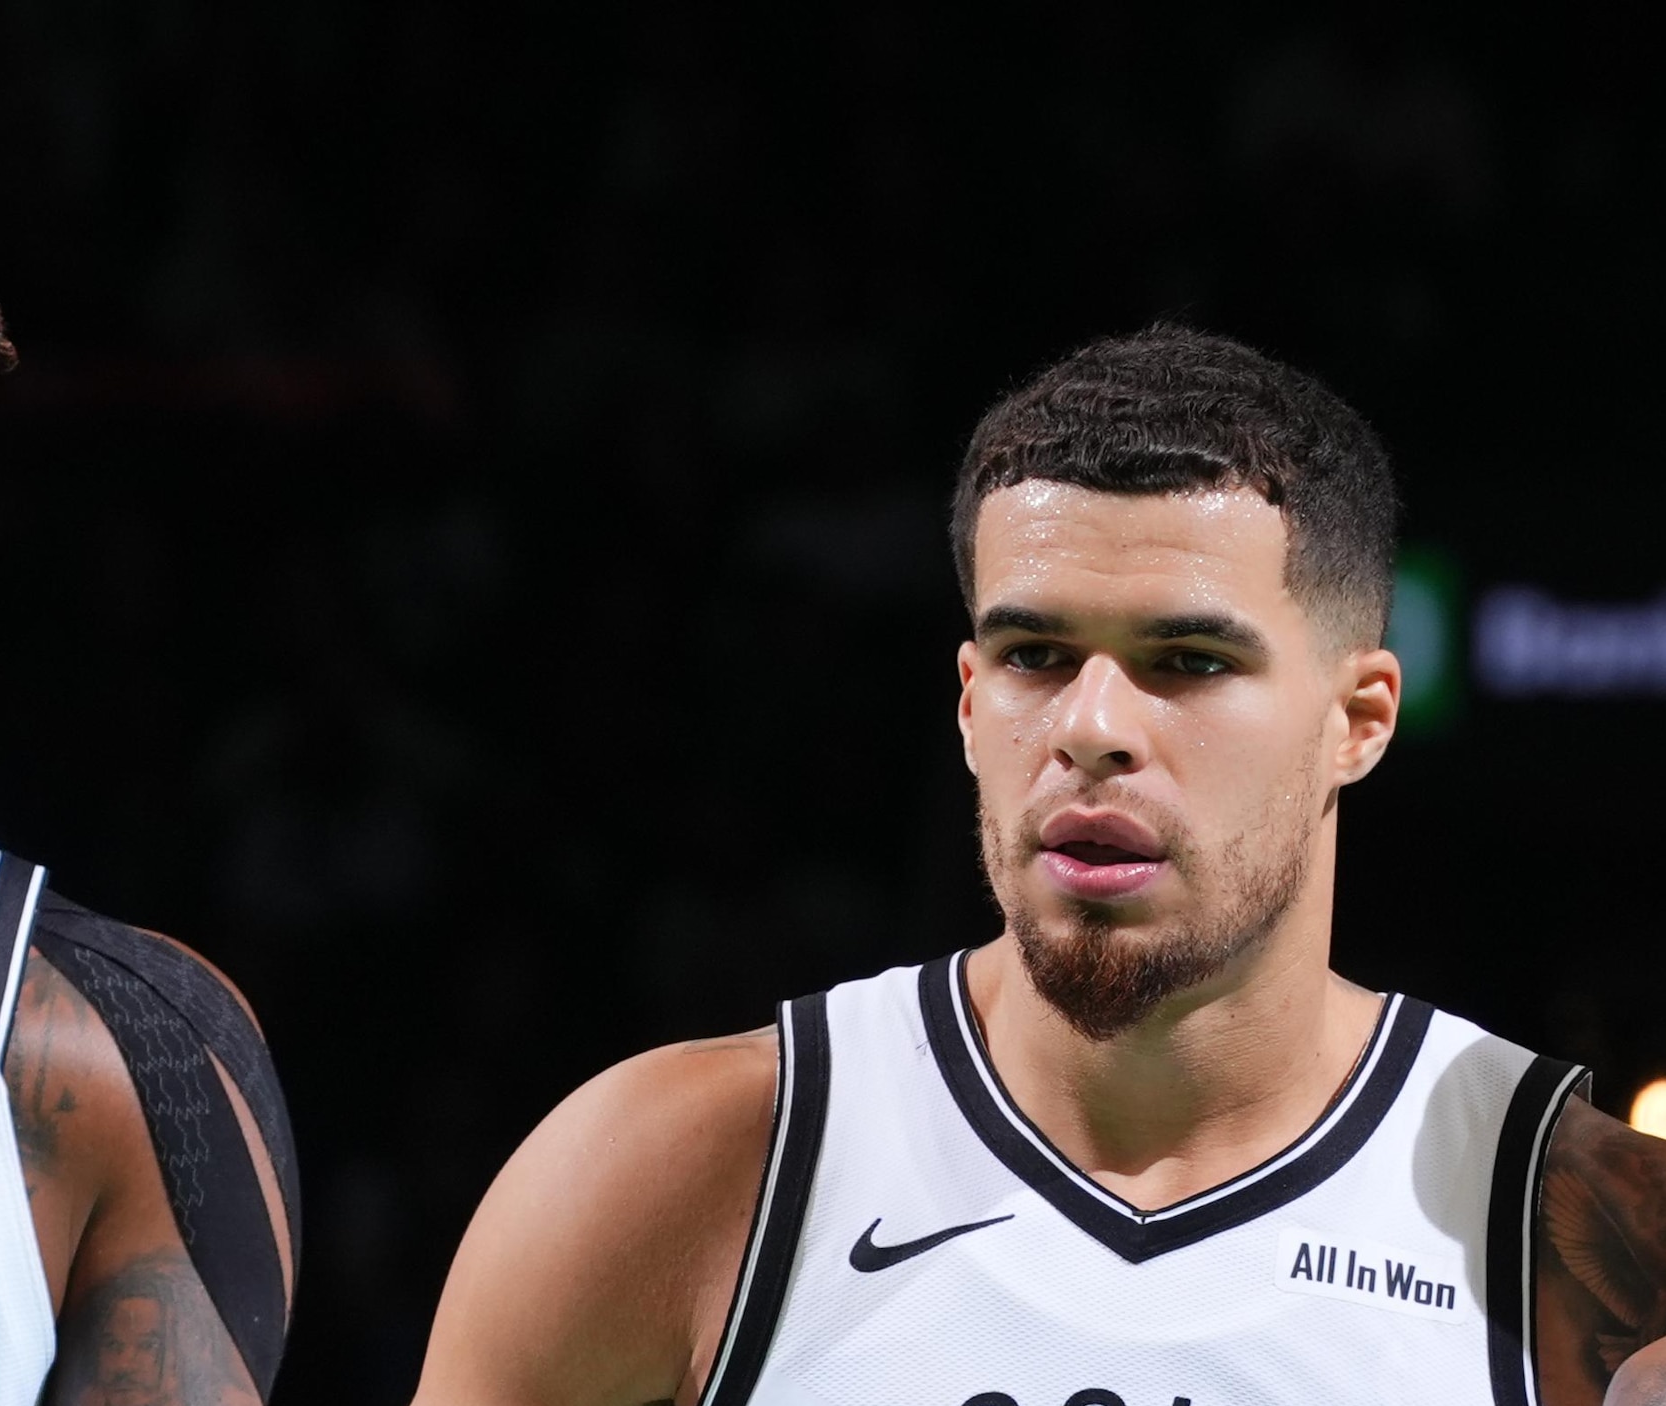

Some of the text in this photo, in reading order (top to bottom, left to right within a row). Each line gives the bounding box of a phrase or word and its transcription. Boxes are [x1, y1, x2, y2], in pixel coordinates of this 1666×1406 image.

[1290, 1242, 1456, 1310] All In Won
